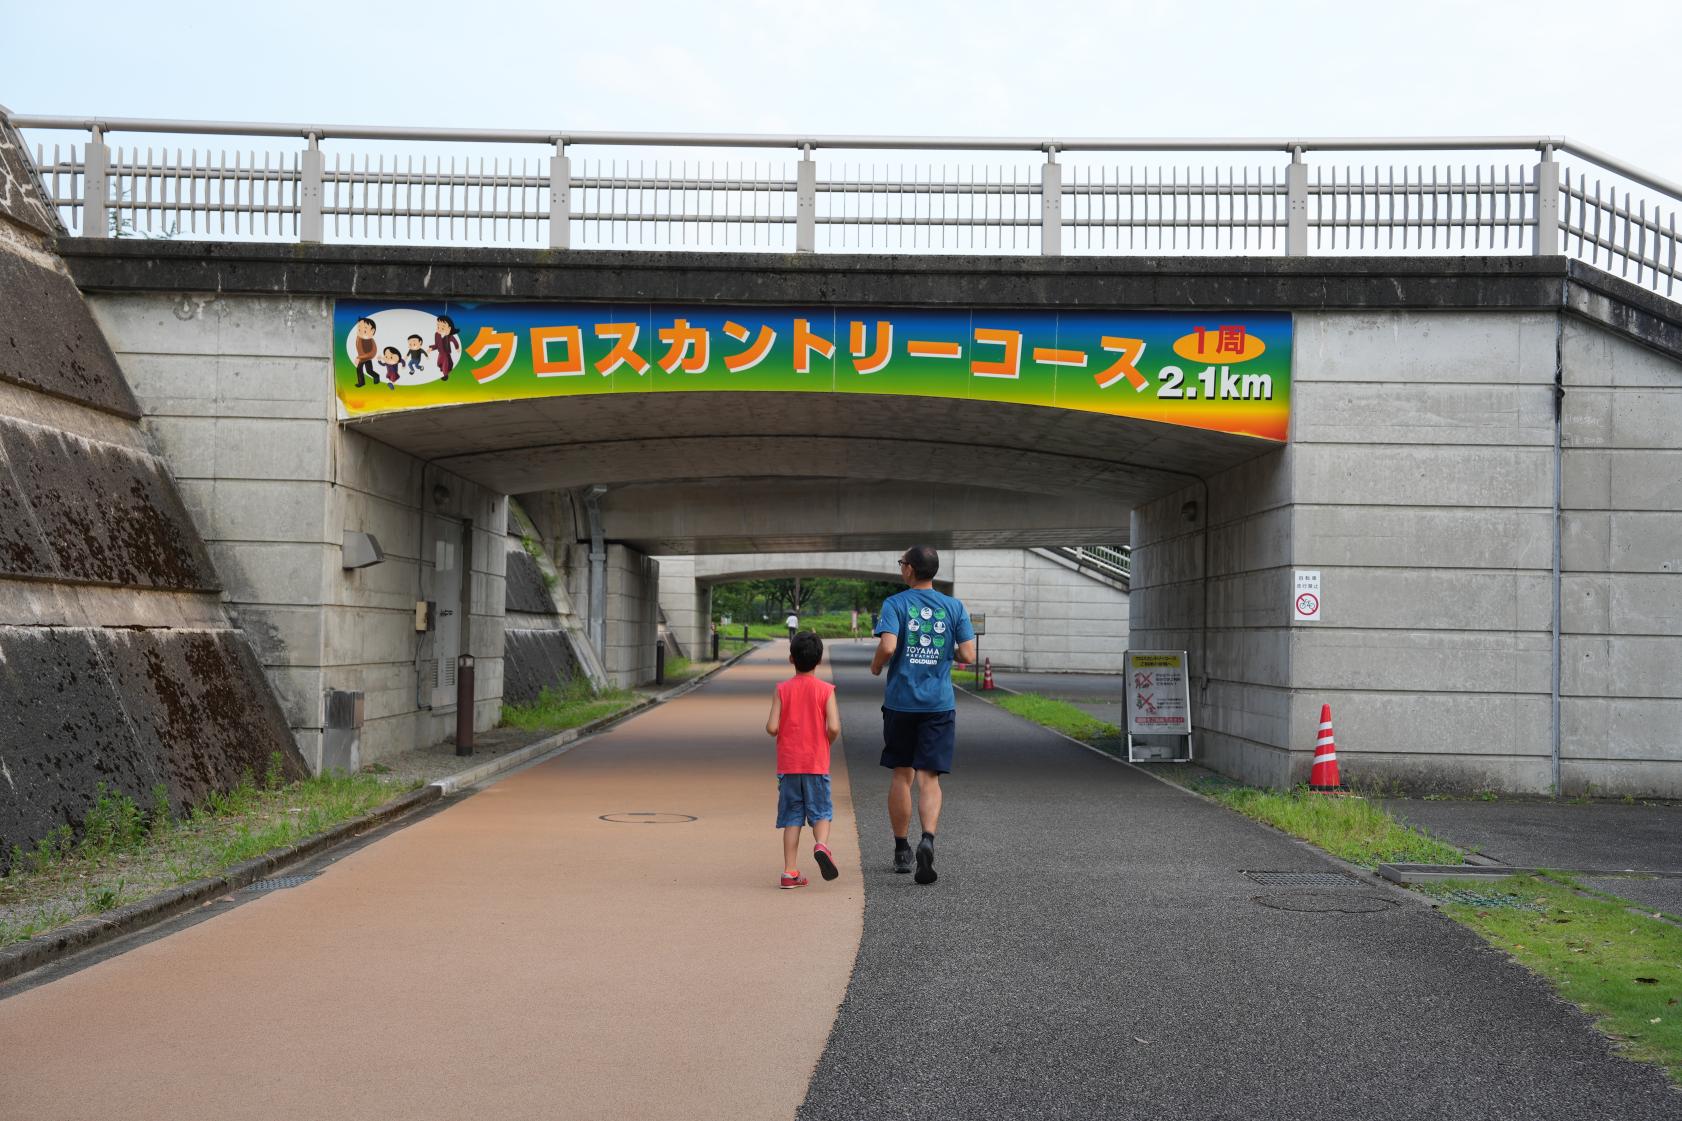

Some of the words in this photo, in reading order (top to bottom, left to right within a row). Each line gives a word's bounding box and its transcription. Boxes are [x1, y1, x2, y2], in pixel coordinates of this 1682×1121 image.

[465, 318, 1149, 393] クロスカントリーコース
[1193, 325, 1246, 355] 1周
[1157, 365, 1272, 400] 2.1km
[906, 646, 939, 655] TOYAMA
